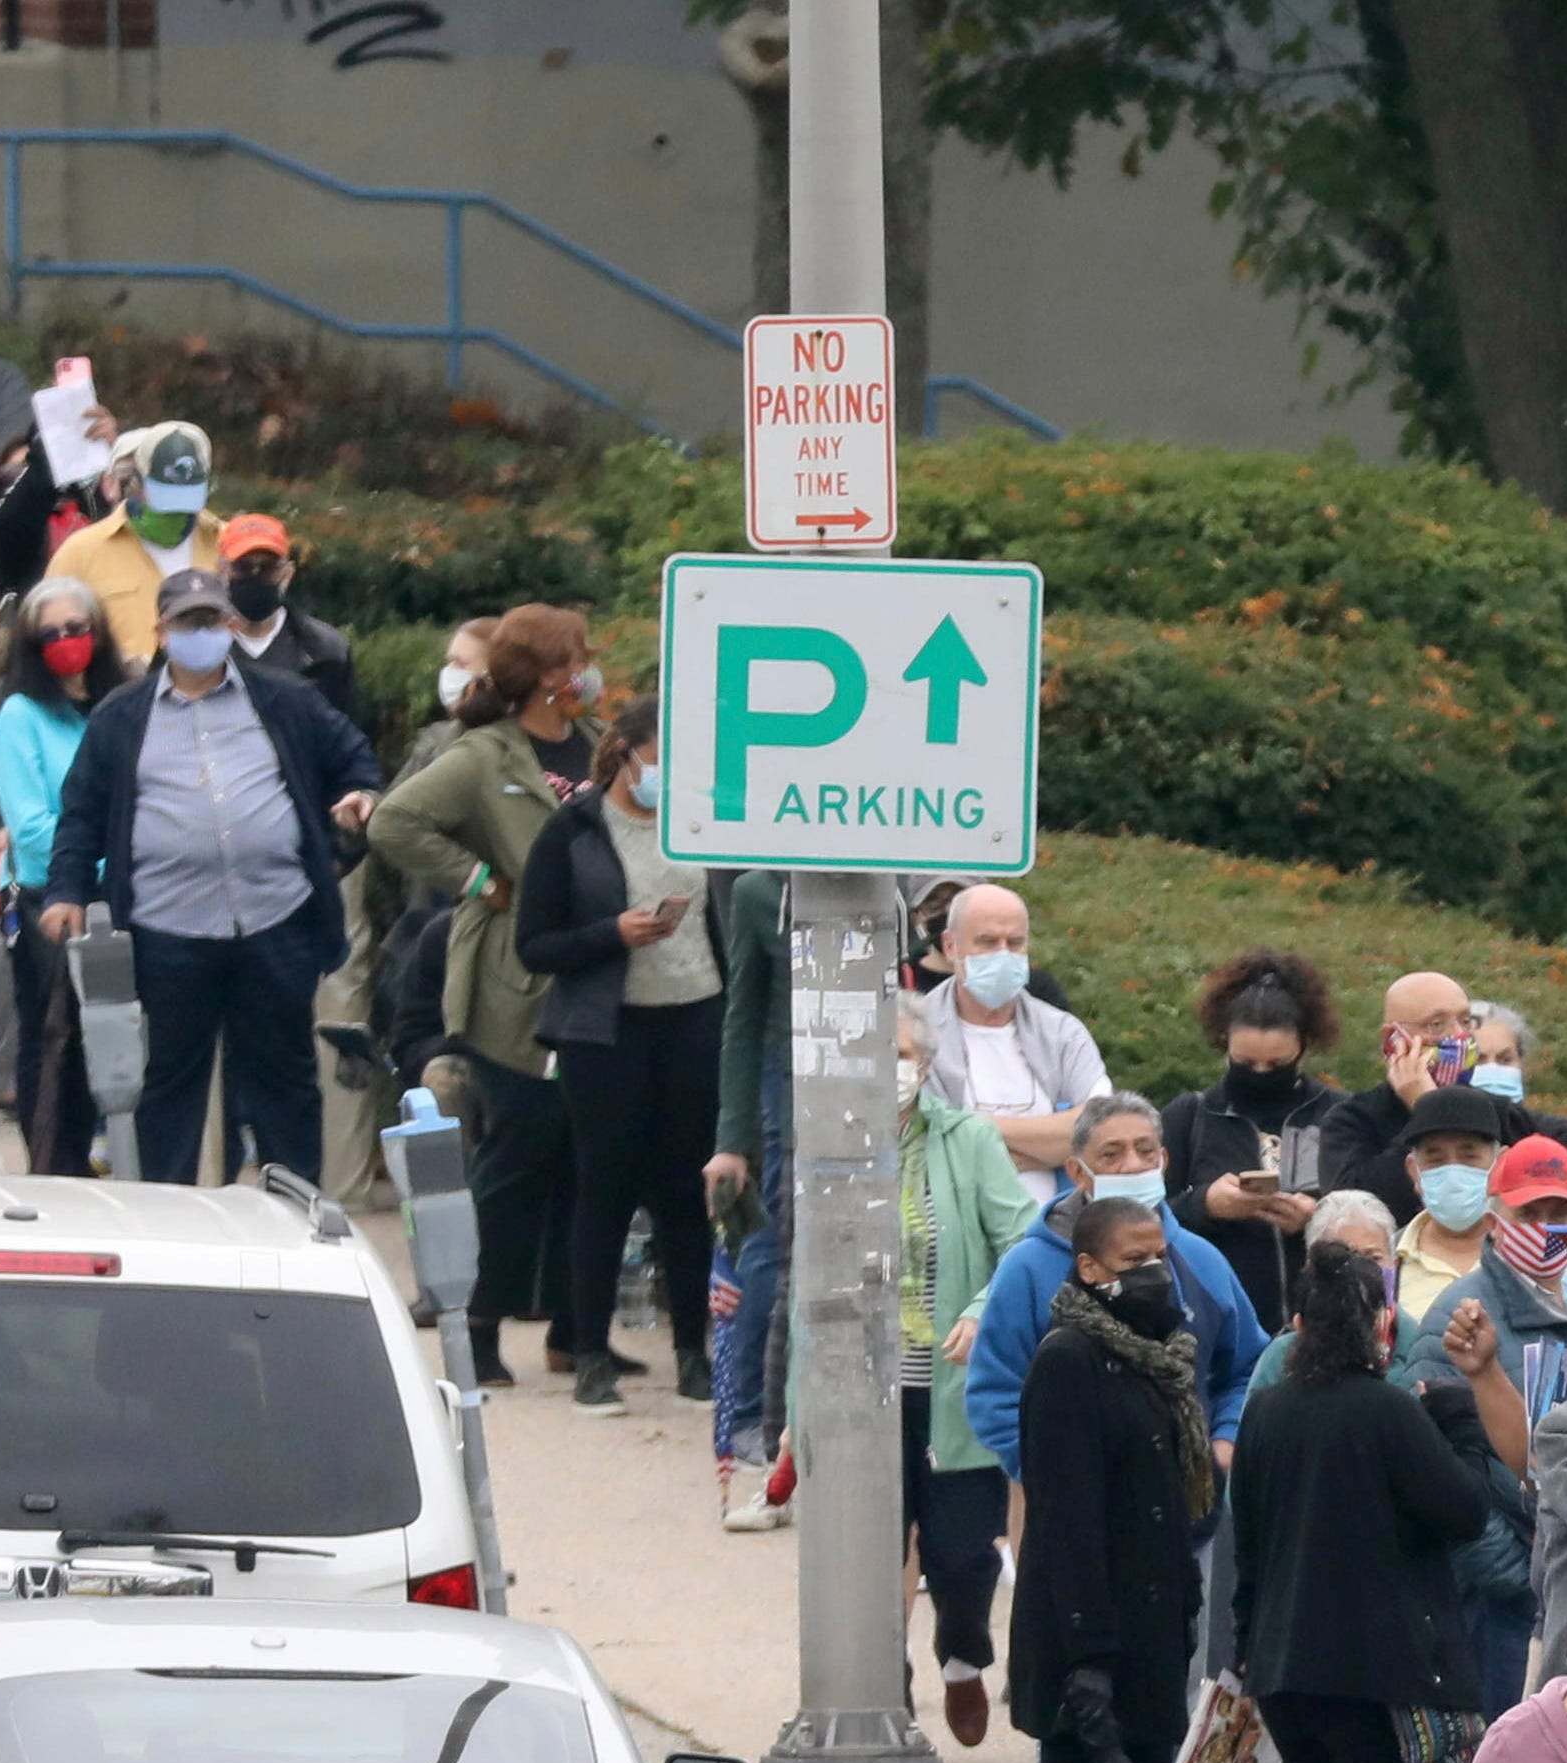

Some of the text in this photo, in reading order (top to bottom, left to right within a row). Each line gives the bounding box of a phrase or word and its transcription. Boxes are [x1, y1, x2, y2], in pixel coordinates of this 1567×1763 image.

[793, 331, 845, 373] NO
[755, 383, 885, 427] PARKING
[796, 436, 844, 462] ANY
[793, 471, 850, 498] TIME
